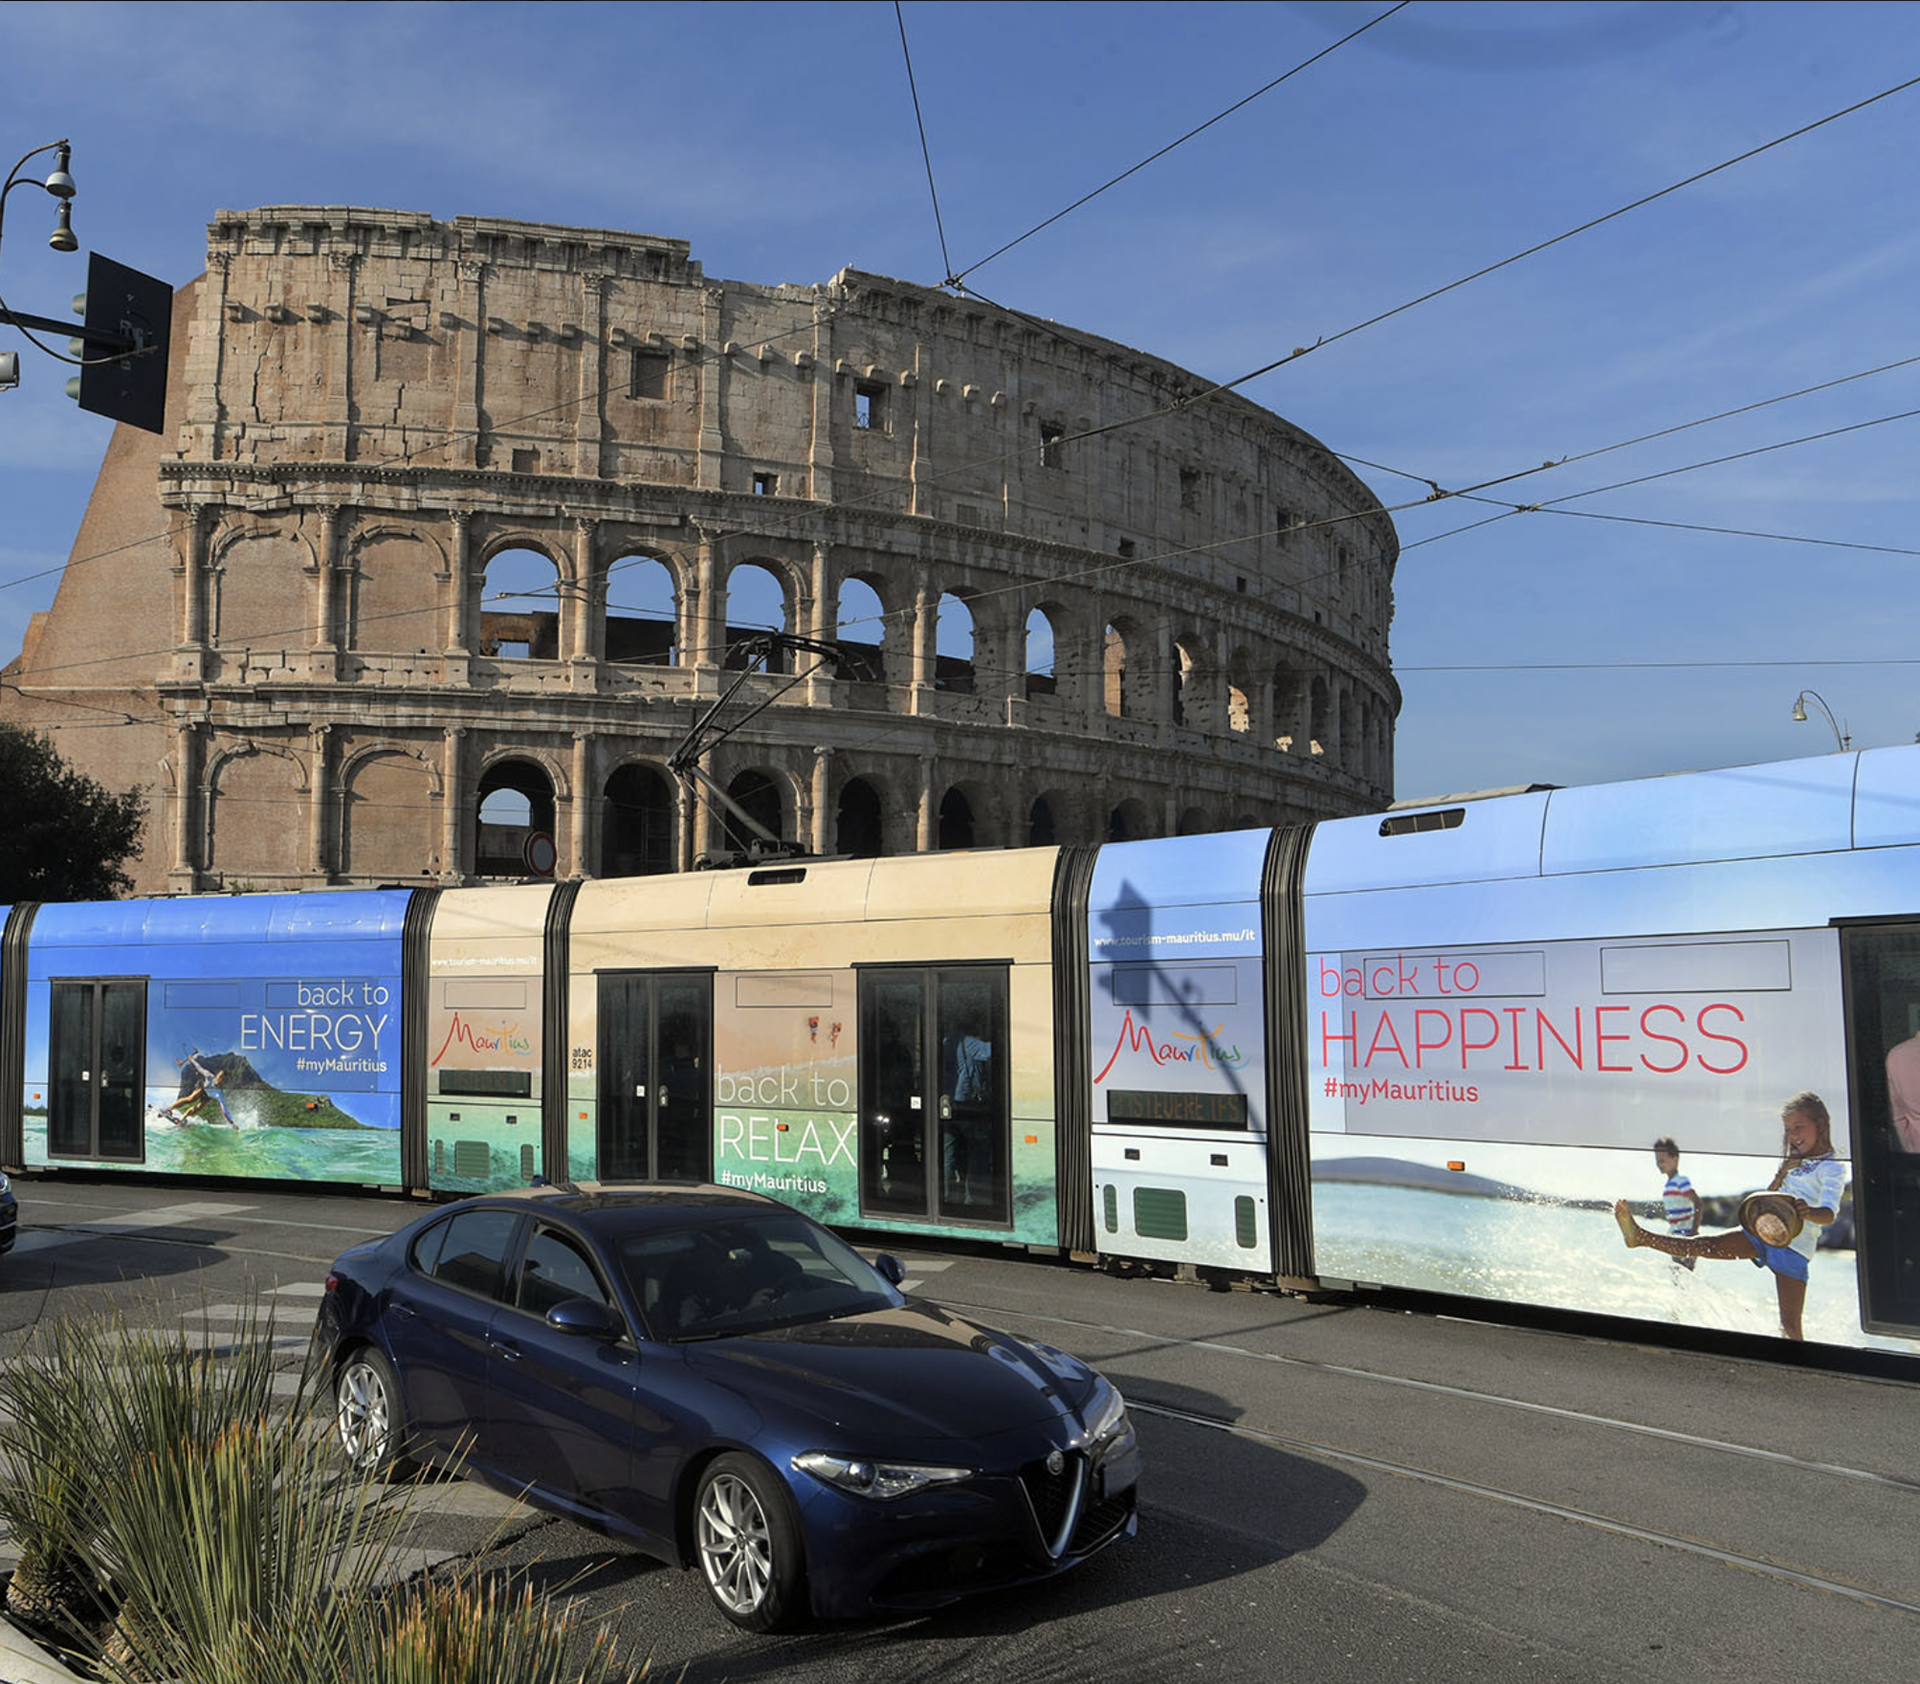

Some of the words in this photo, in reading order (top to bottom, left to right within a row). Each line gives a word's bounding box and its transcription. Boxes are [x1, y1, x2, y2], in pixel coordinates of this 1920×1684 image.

[1093, 928, 1256, 947] www.tourism-mauritius.mu/it
[1320, 954, 1419, 998] back
[1433, 957, 1480, 995] to
[297, 979, 355, 1007] back
[362, 981, 390, 1006] to
[240, 1013, 388, 1051] ENERGY
[431, 1011, 532, 1066] Mauritius
[1093, 1009, 1245, 1084] Mauritius
[1322, 1003, 1749, 1075] HAPPINESS
[296, 1056, 388, 1076] #myMauritius
[571, 1047, 593, 1058] atac
[571, 1058, 593, 1070] 9214
[717, 1063, 799, 1105] back
[810, 1070, 850, 1107] to
[1324, 1077, 1479, 1105] #myMauritius
[720, 1114, 857, 1168] RELAX
[720, 1169, 827, 1194] #myMauritius
